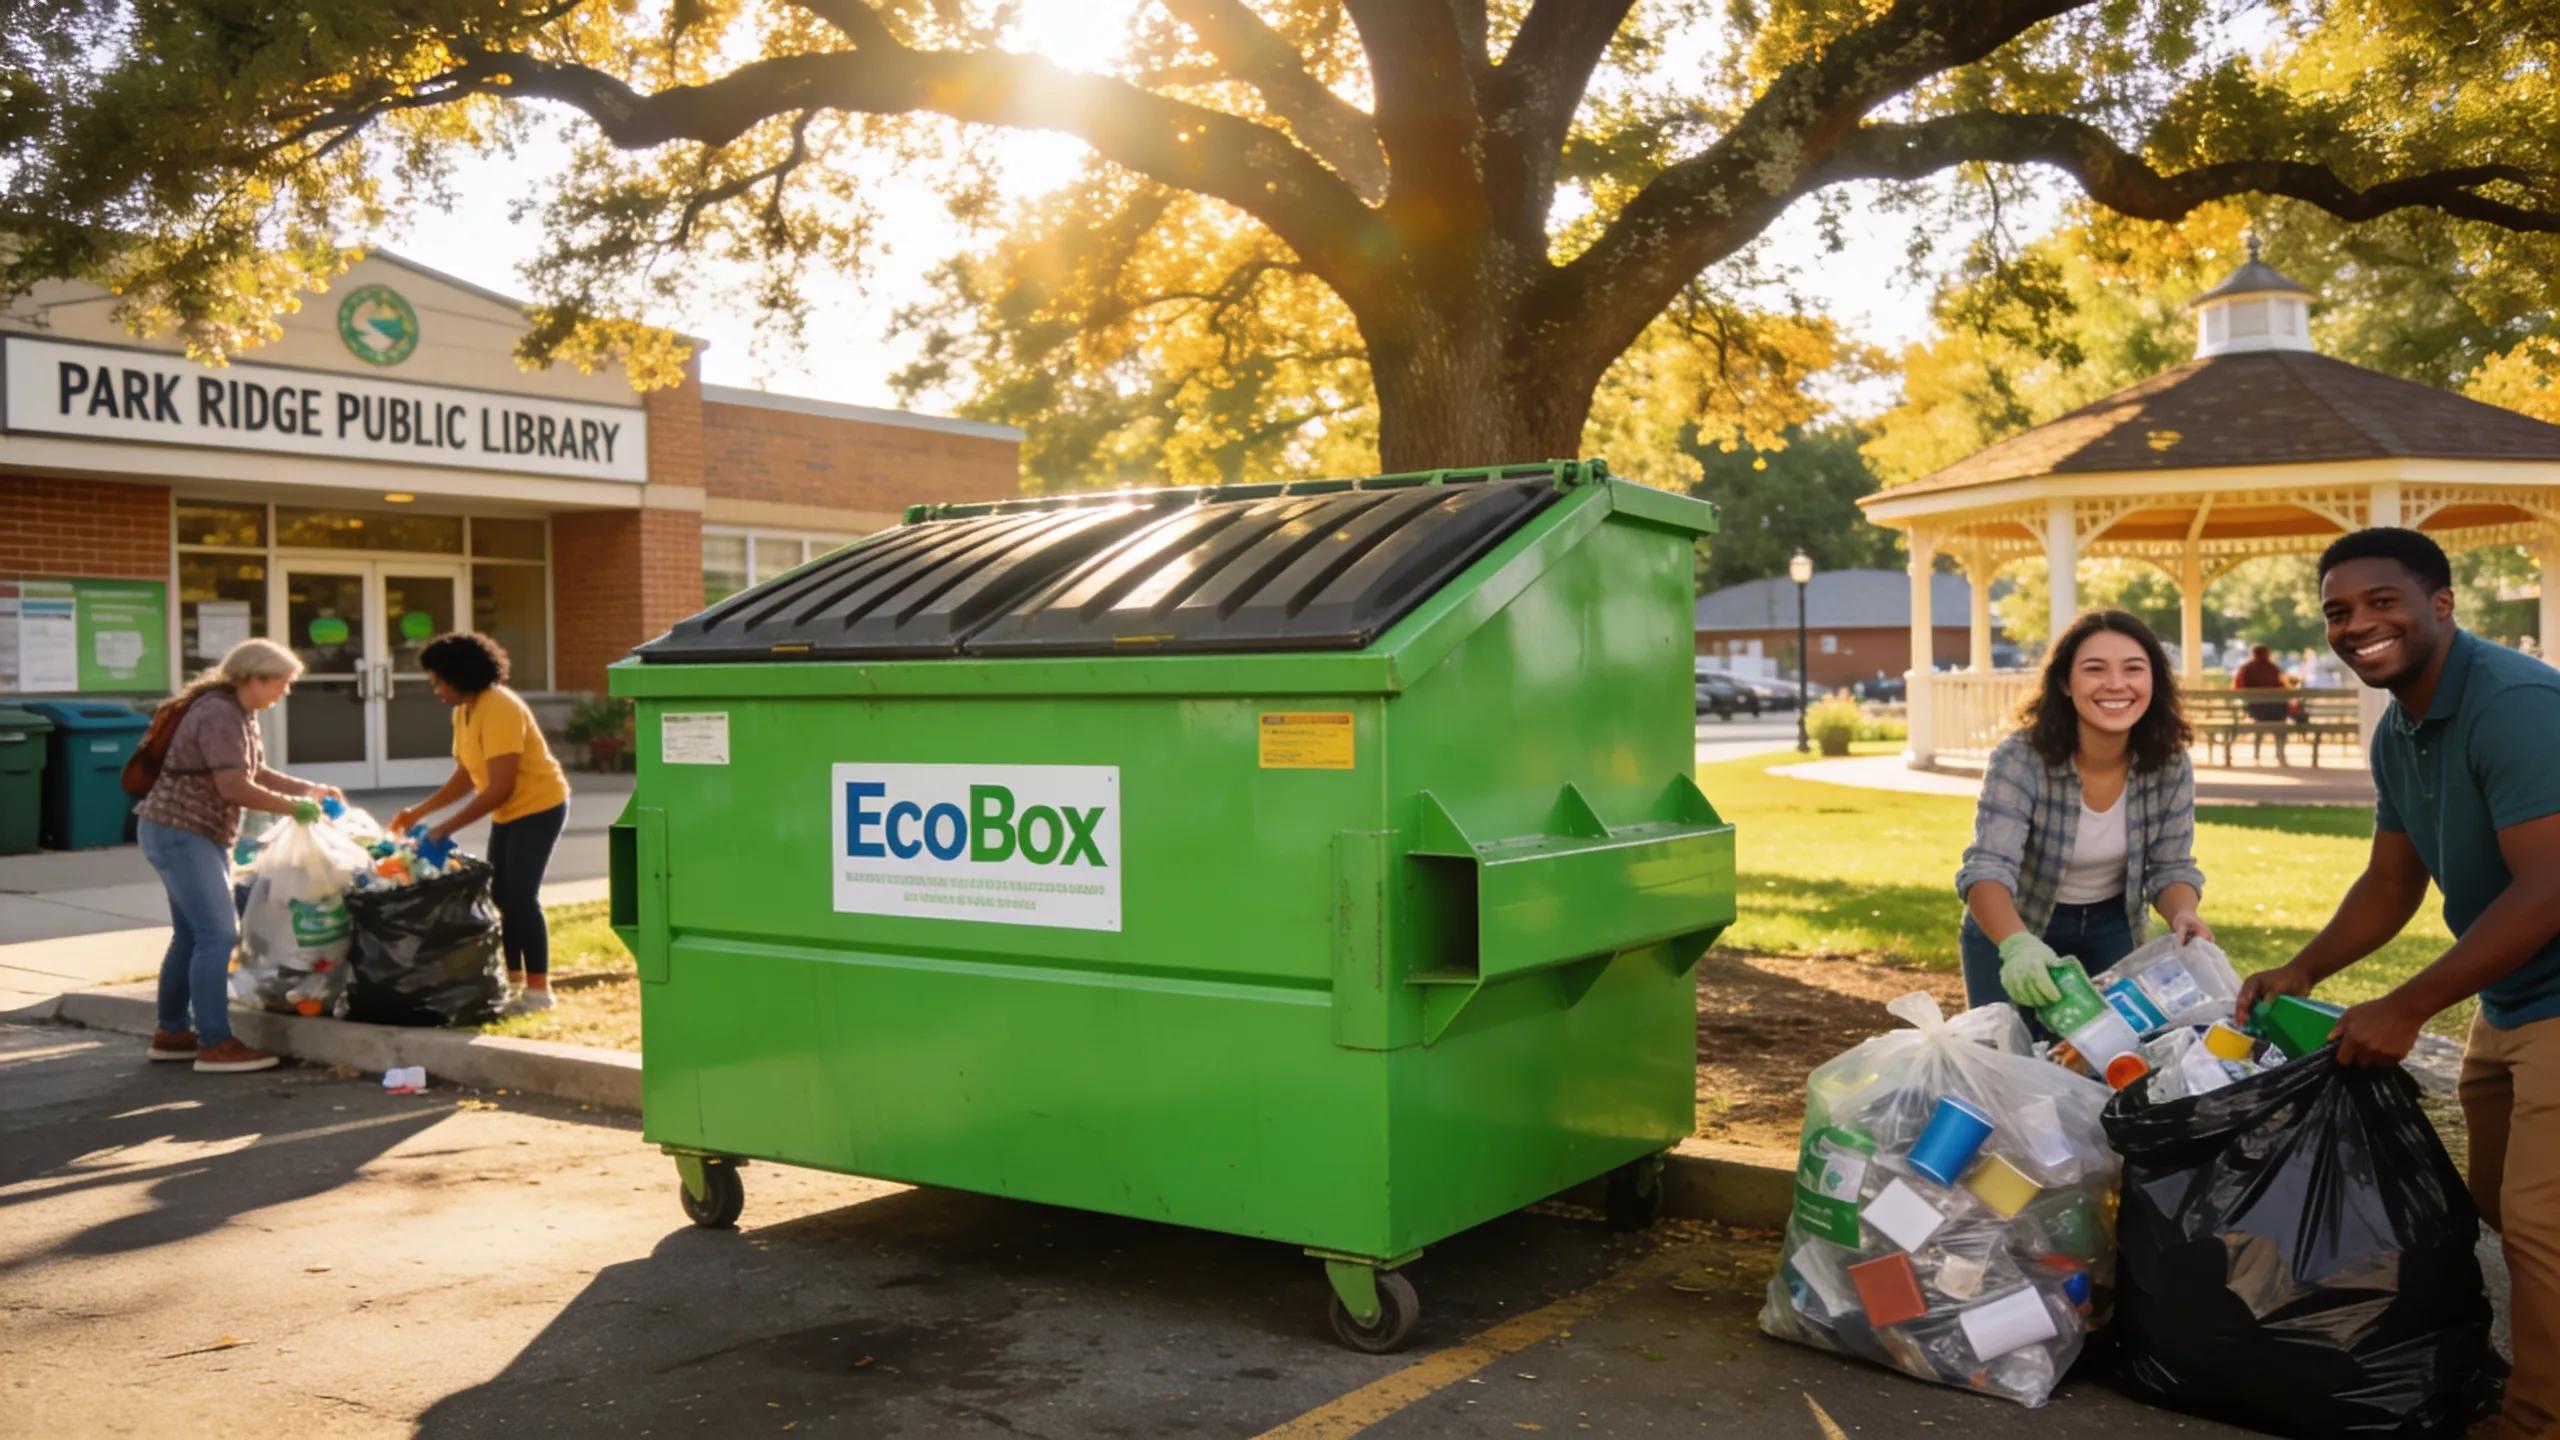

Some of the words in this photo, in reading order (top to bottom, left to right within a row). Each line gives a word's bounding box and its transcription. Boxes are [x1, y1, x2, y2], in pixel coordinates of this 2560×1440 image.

[58, 361, 182, 424] PARK
[197, 376, 323, 437] RIDGE
[337, 392, 467, 449] PUBLIC
[481, 408, 621, 463] LIBRARY
[845, 781, 1108, 867] EcoBox
